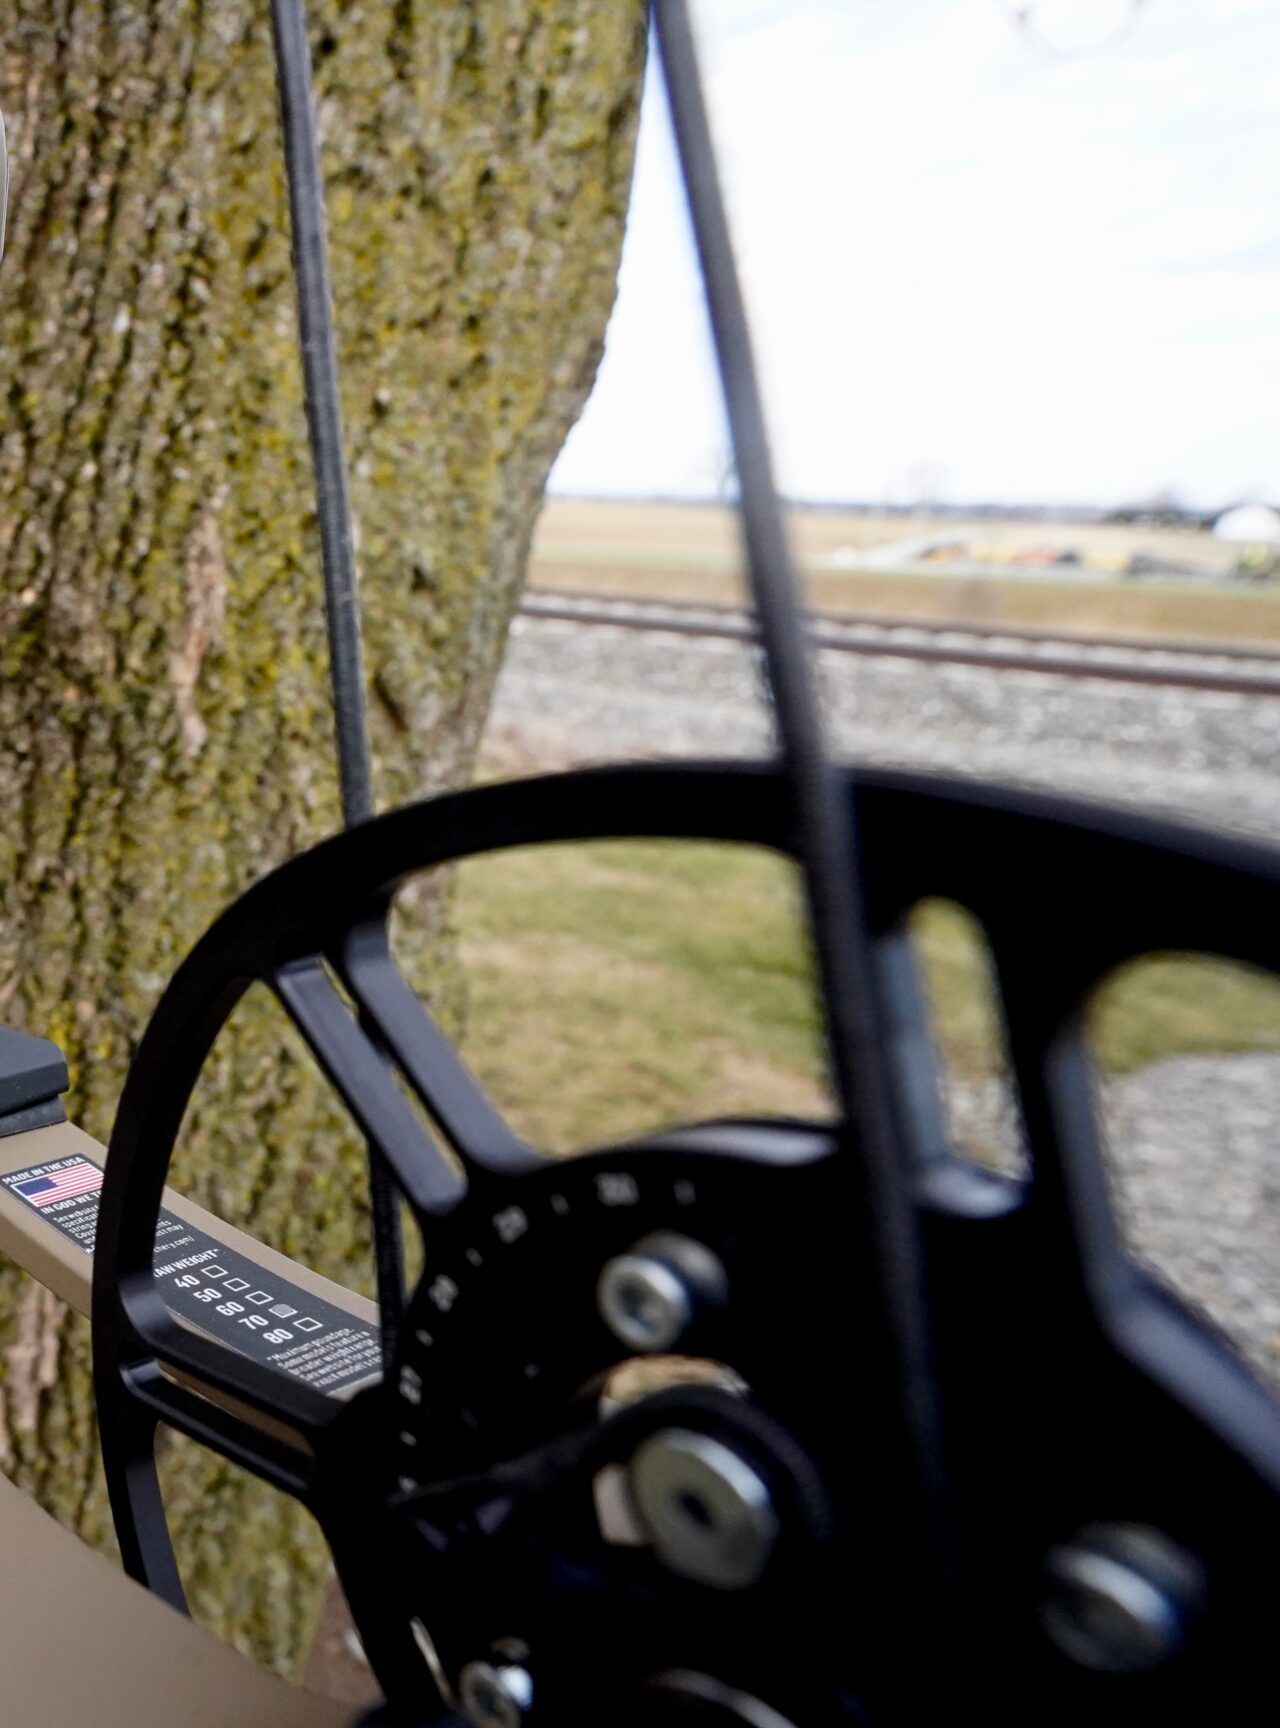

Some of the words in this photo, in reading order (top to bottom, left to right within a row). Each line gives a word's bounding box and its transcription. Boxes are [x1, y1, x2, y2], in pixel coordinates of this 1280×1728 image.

[2, 1171, 32, 1184] MADE
[31, 1168, 45, 1176] IN
[43, 1163, 65, 1173] THE
[63, 1156, 86, 1167] USA
[40, 1206, 55, 1215] IN
[53, 1199, 77, 1211] GOD
[74, 1194, 93, 1204] WE
[68, 1223, 93, 1233] string
[153, 1264, 176, 1278] AW
[174, 1274, 200, 1288] 40
[193, 1288, 222, 1302] 50
[215, 1301, 245, 1316] 60
[238, 1314, 269, 1330] 70
[262, 1328, 294, 1344] 80
